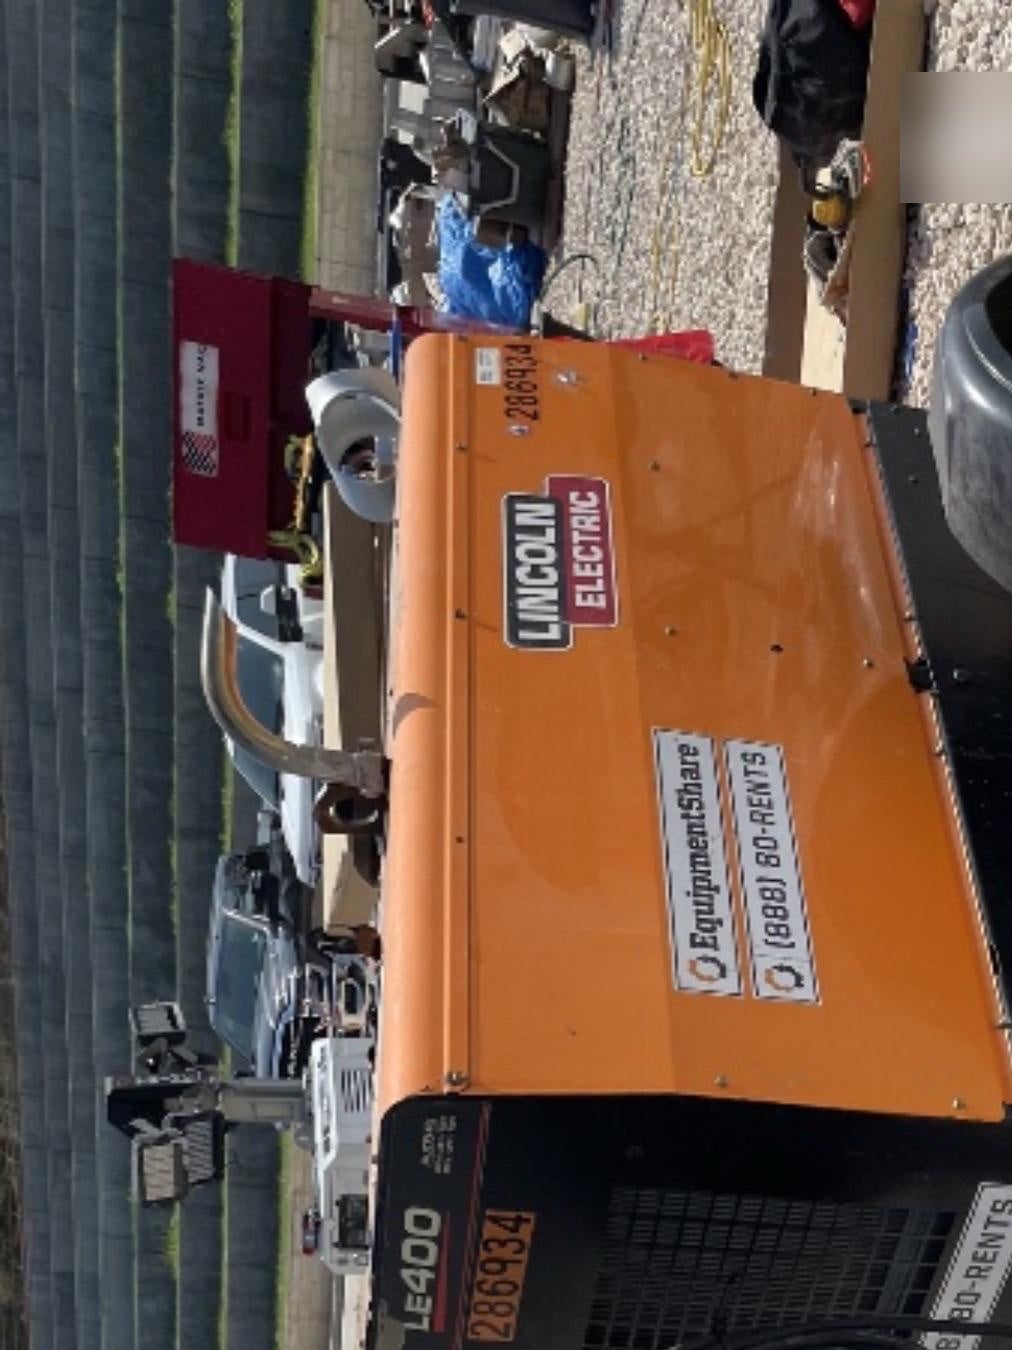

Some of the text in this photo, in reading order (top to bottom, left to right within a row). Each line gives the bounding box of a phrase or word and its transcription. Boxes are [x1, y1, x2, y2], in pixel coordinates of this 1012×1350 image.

[503, 344, 539, 421] 286934
[514, 502, 562, 640] LINCOLN
[569, 490, 607, 609] ELECTRIC
[677, 744, 723, 951] EquipmentShare
[741, 751, 795, 949] (888) 80-RENTS
[400, 1206, 442, 1332] LE400
[468, 1213, 532, 1339] 286934
